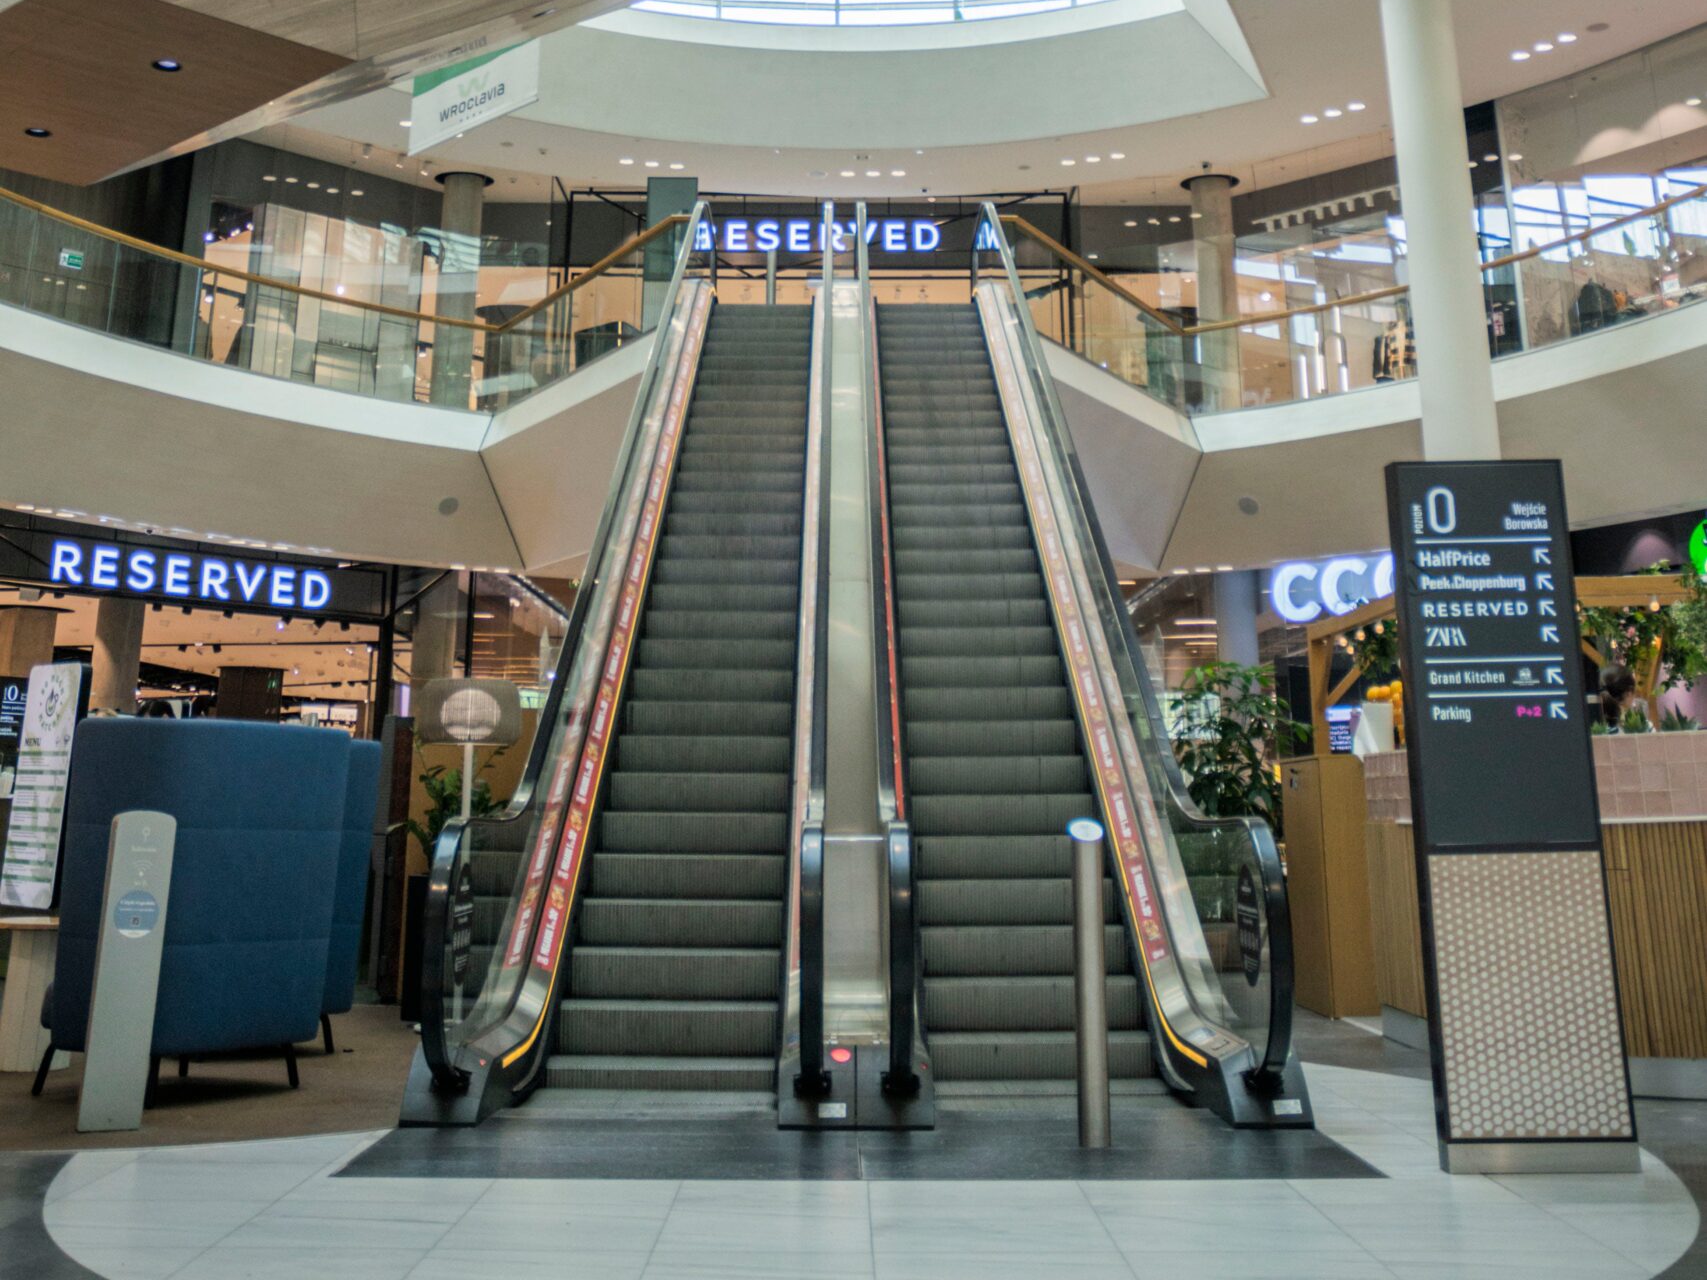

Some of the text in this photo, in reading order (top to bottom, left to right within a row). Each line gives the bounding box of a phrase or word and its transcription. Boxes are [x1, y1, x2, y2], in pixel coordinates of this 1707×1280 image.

[1511, 503, 1547, 517] Wejście
[1504, 517, 1549, 530] Borowska
[1419, 551, 1491, 567] HalfPrice
[52, 543, 331, 608] RESERVED
[1423, 601, 1528, 617] RESERVED
[1426, 626, 1467, 646] ZARA
[1429, 671, 1461, 685] Grand
[1464, 671, 1505, 684] Kitchen
[1432, 704, 1542, 722] Parking P+2
